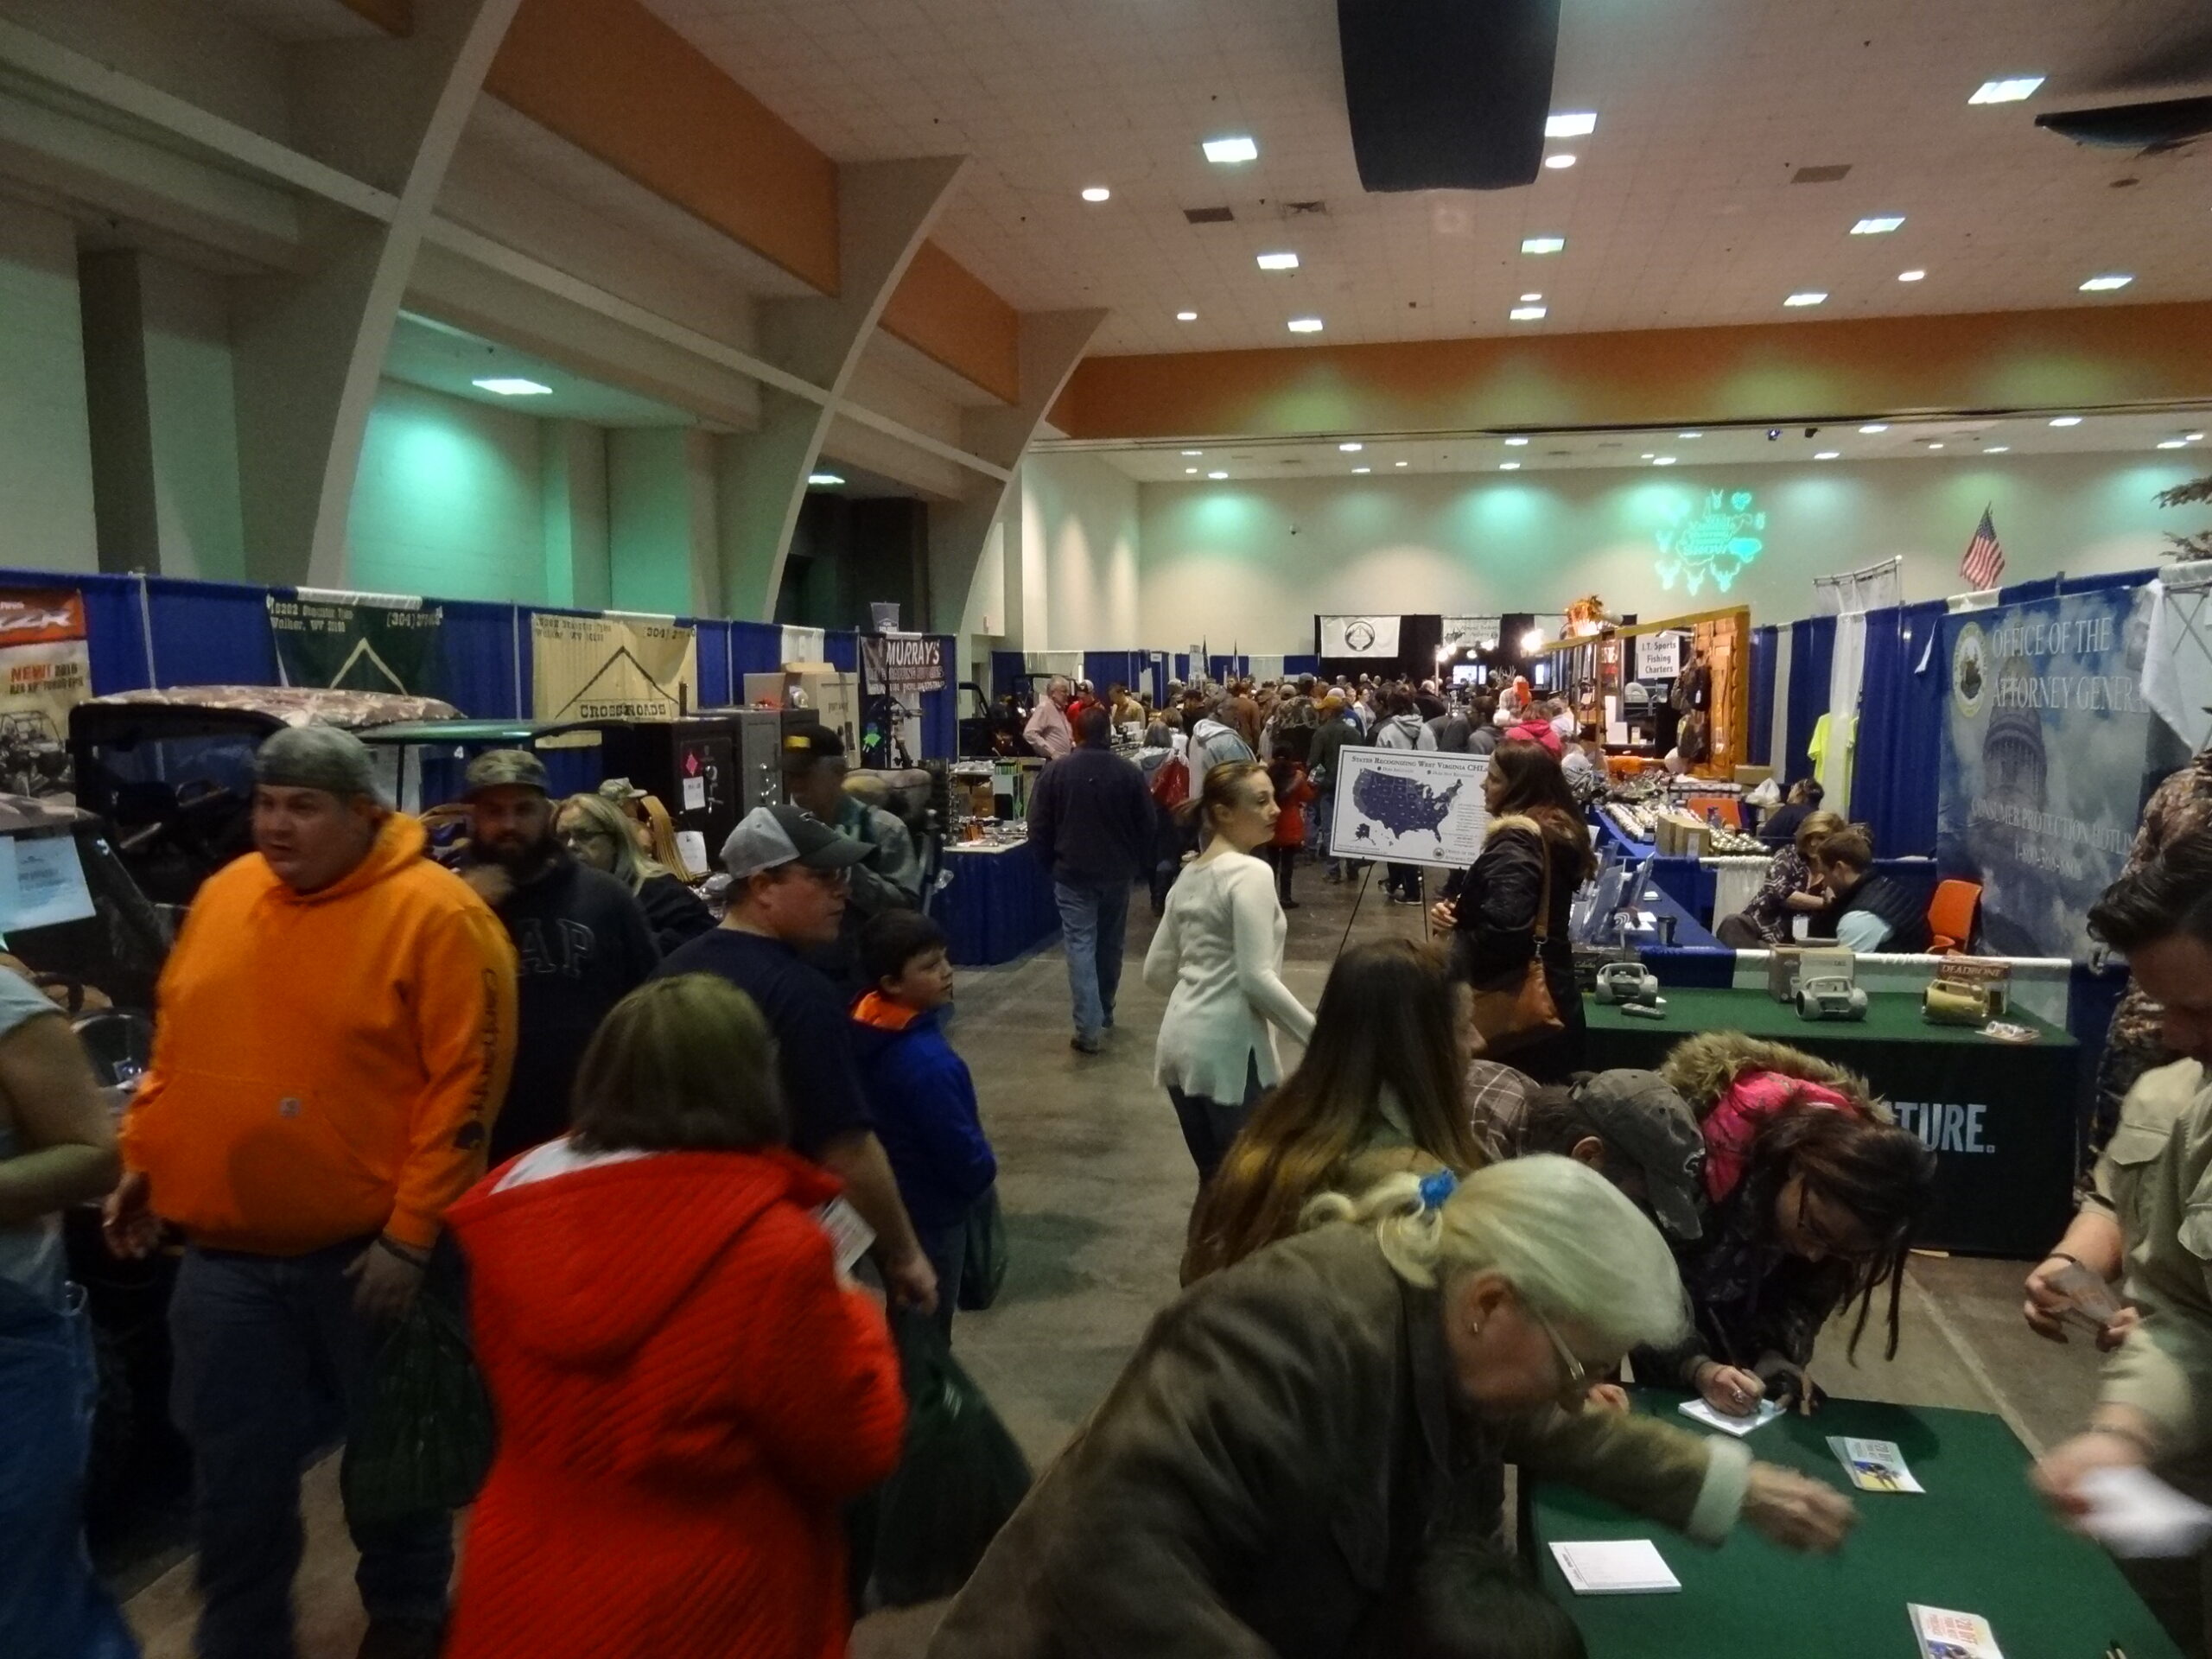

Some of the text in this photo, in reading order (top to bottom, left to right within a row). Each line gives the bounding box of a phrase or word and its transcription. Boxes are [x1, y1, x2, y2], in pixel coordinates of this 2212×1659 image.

[1654, 641, 1676, 652] Sports
[1993, 617, 2111, 658] OFFICE OF THE
[886, 639, 940, 665] MURRAY'S
[1647, 654, 1672, 664] Fishing
[1645, 665, 1673, 674] Charters
[1992, 677, 2074, 709] ATTORNEY
